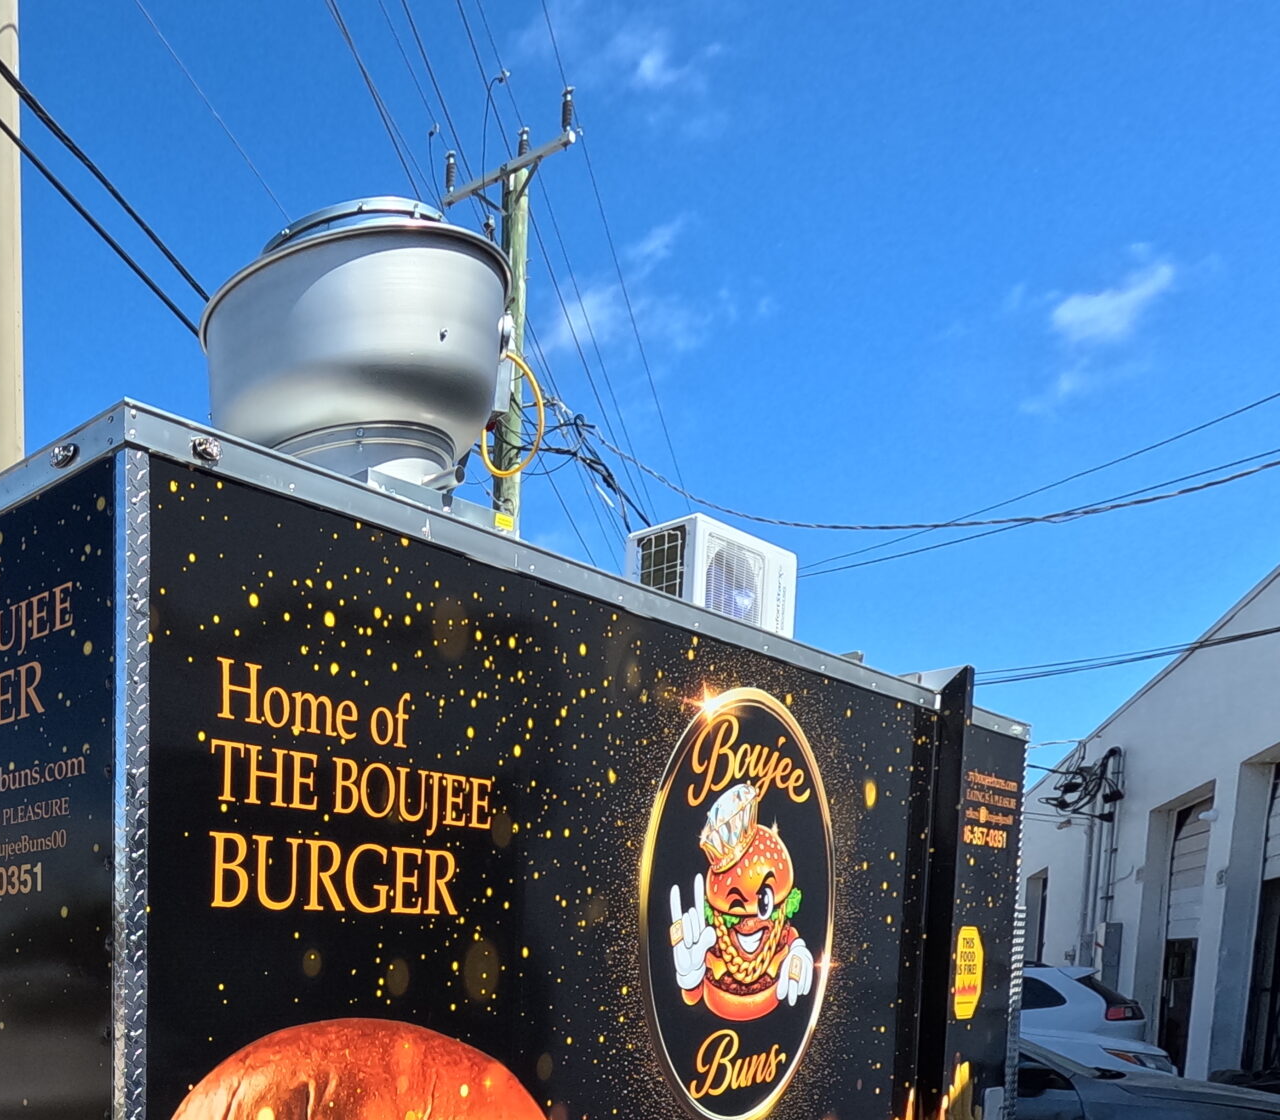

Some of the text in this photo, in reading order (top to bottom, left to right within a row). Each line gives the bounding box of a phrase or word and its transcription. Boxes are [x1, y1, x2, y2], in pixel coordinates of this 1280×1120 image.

[217, 656, 411, 748] Home of
[210, 738, 492, 836] THE BOUJEE
[687, 713, 811, 807] Boujee
[3, 797, 70, 826] PLEASURE
[209, 830, 458, 915] BURGER
[960, 951, 976, 962] FOOD
[962, 938, 975, 949] THIS
[690, 1029, 786, 1100] Buns
